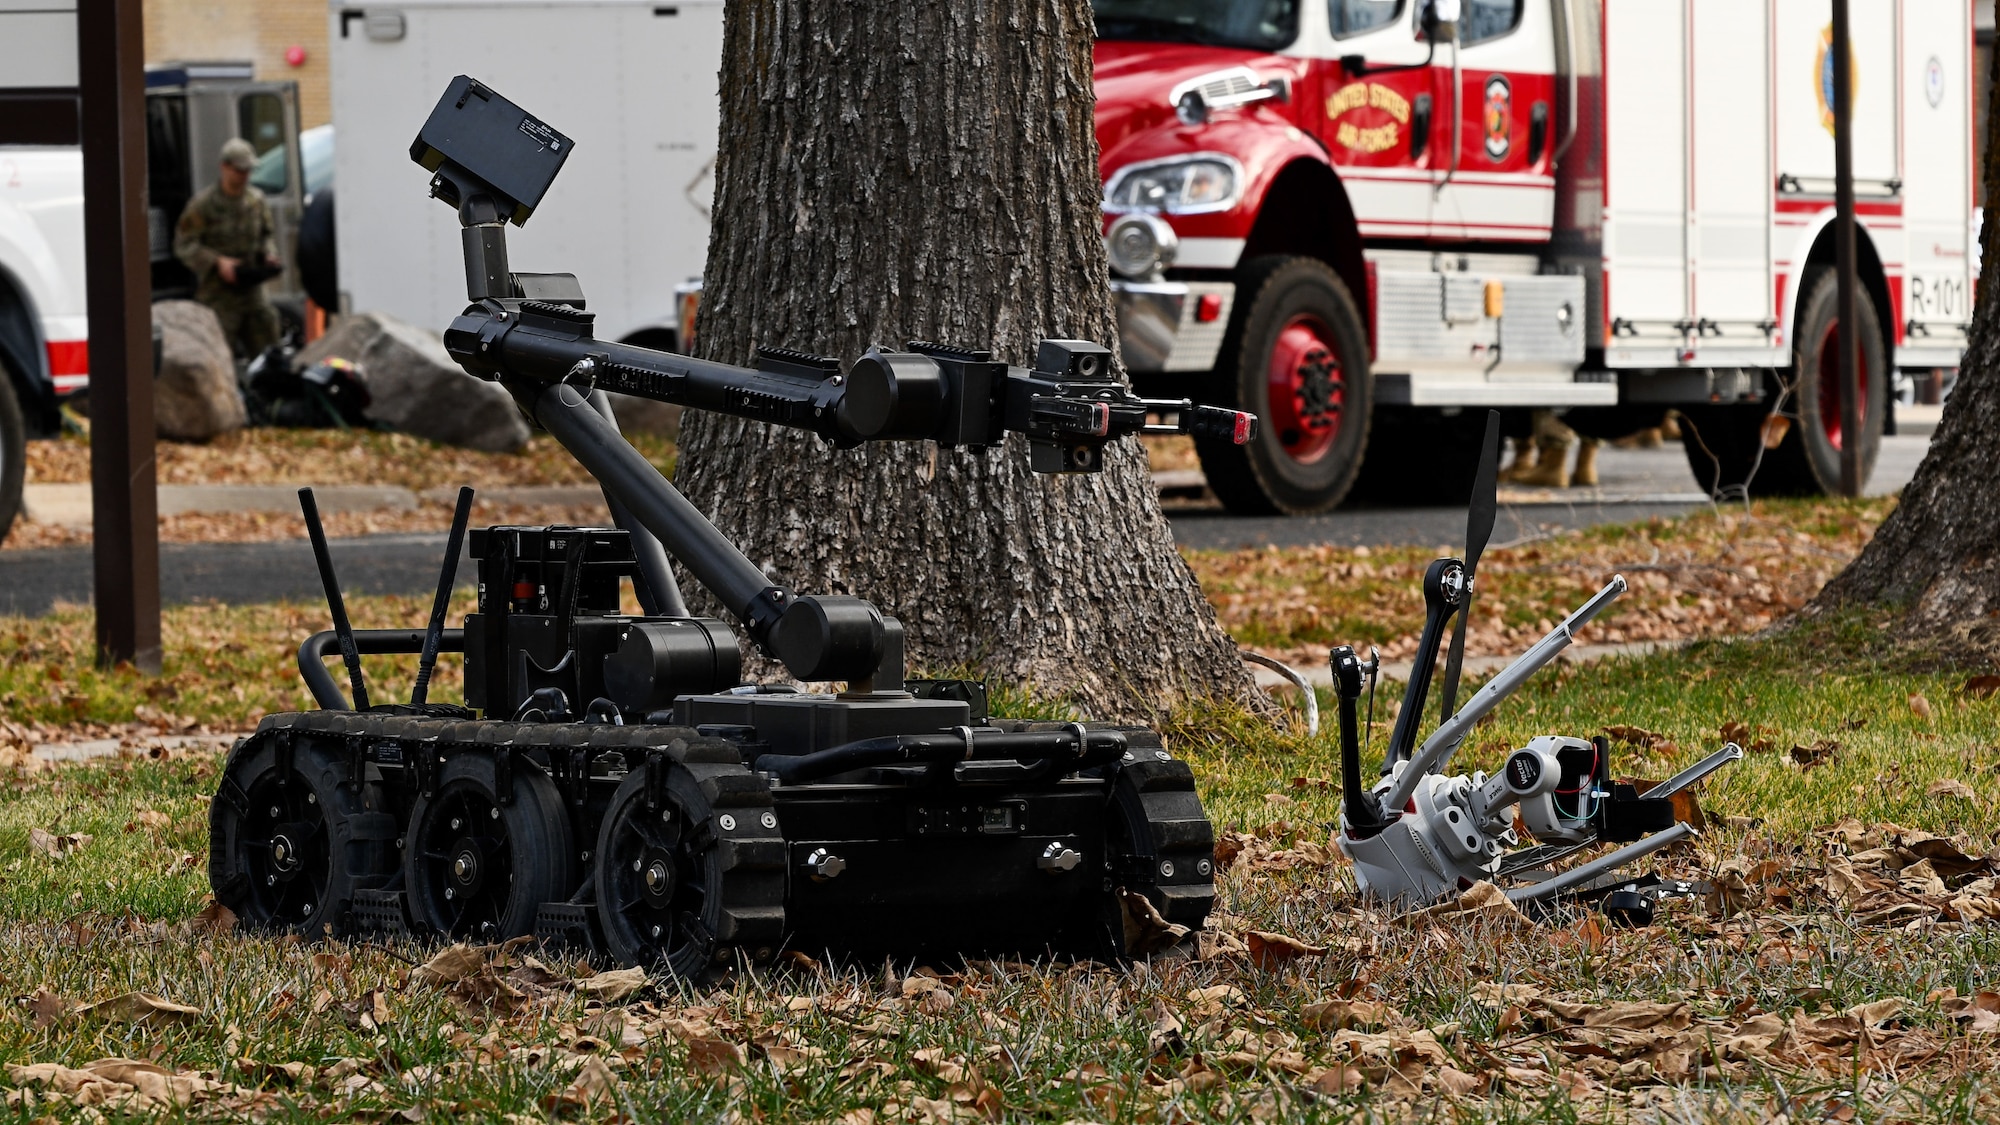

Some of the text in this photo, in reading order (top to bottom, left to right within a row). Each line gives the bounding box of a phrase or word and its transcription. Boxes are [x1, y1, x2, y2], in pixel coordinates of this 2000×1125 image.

[1325, 82, 1410, 124] UNITED STATES
[1359, 121, 1399, 153] FORCE
[1515, 759, 1528, 785] Vector
